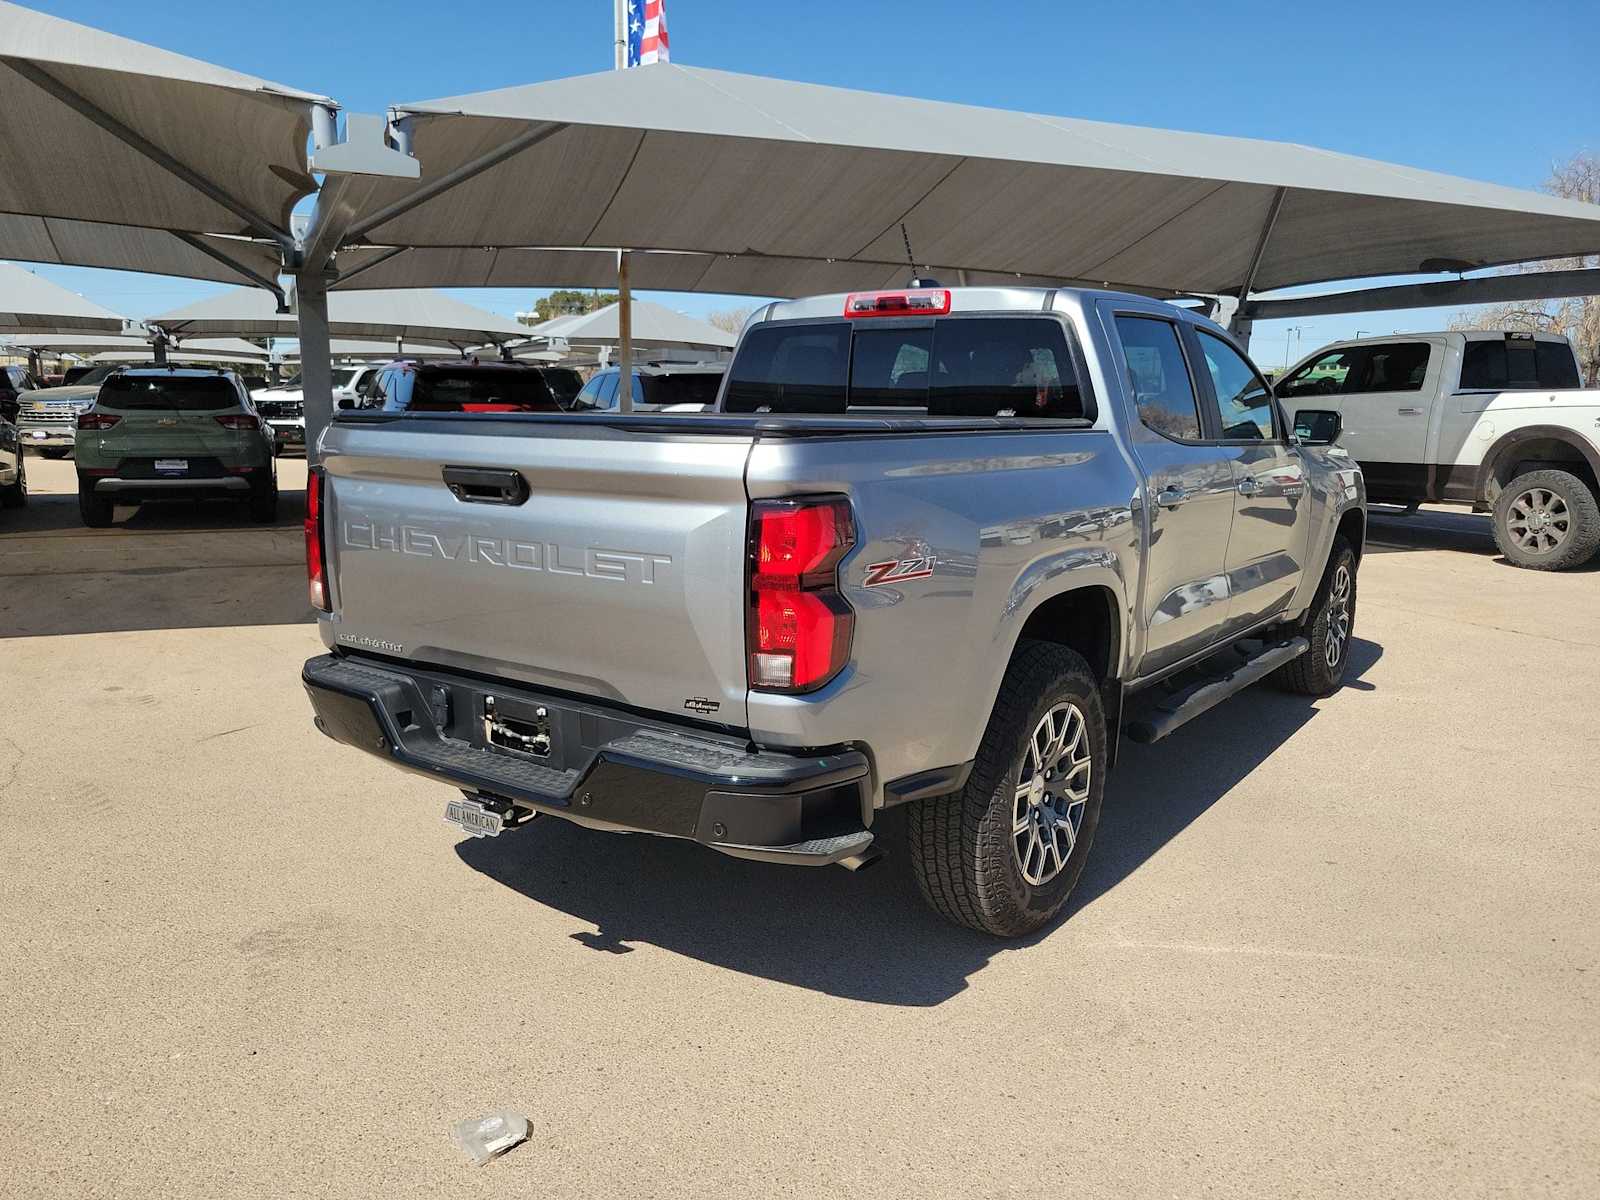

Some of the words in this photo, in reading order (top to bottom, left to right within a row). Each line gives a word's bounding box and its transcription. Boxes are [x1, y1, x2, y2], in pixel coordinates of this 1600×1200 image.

[344, 520, 672, 584] CHEVROLET
[864, 556, 937, 588] Z71
[449, 806, 461, 820] ALL
[462, 810, 496, 831] AMERICAN
